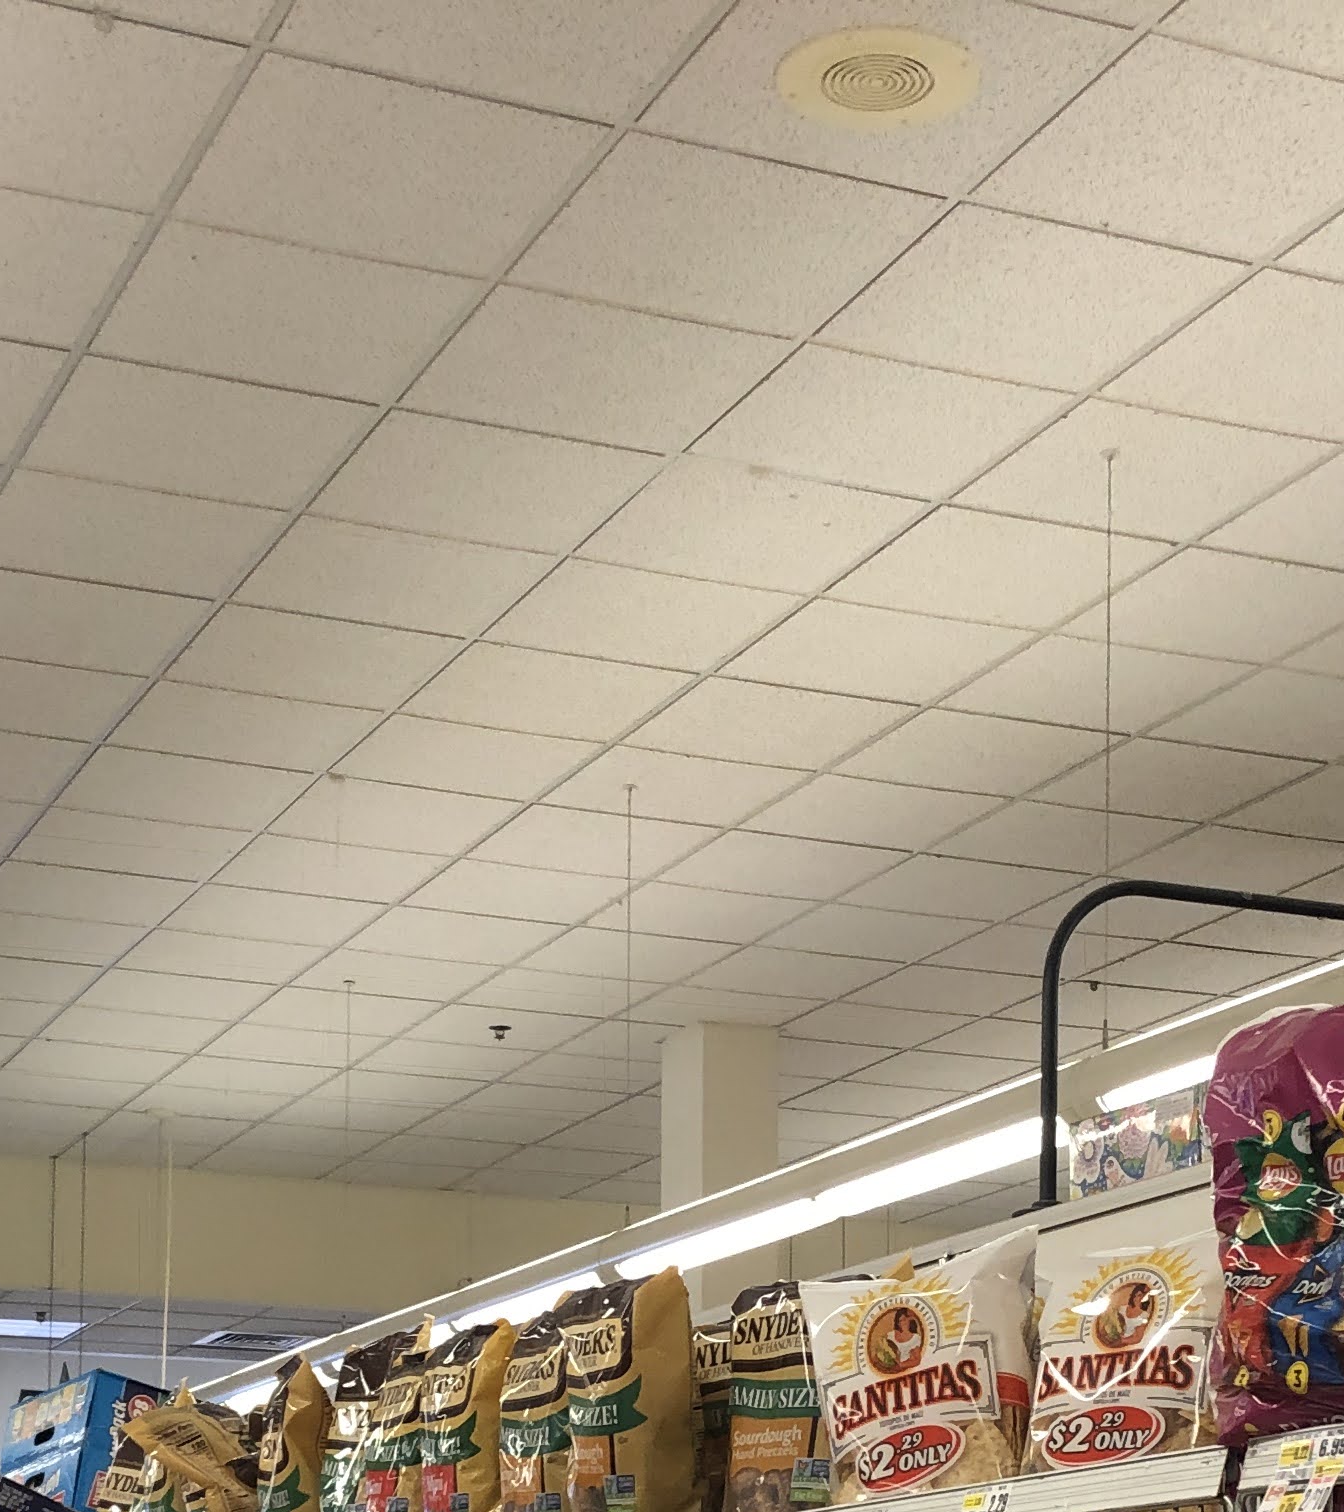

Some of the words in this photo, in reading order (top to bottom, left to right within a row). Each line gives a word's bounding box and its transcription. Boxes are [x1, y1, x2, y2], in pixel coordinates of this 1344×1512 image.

[1039, 1344, 1195, 1403] SANTITAS
[1293, 1369, 1303, 1386] 3
[833, 1359, 982, 1440] SANTITAS
[734, 1426, 801, 1448] Sourdough
[1095, 1429, 1150, 1450] ONLY
[899, 1443, 950, 1472] ONLY
